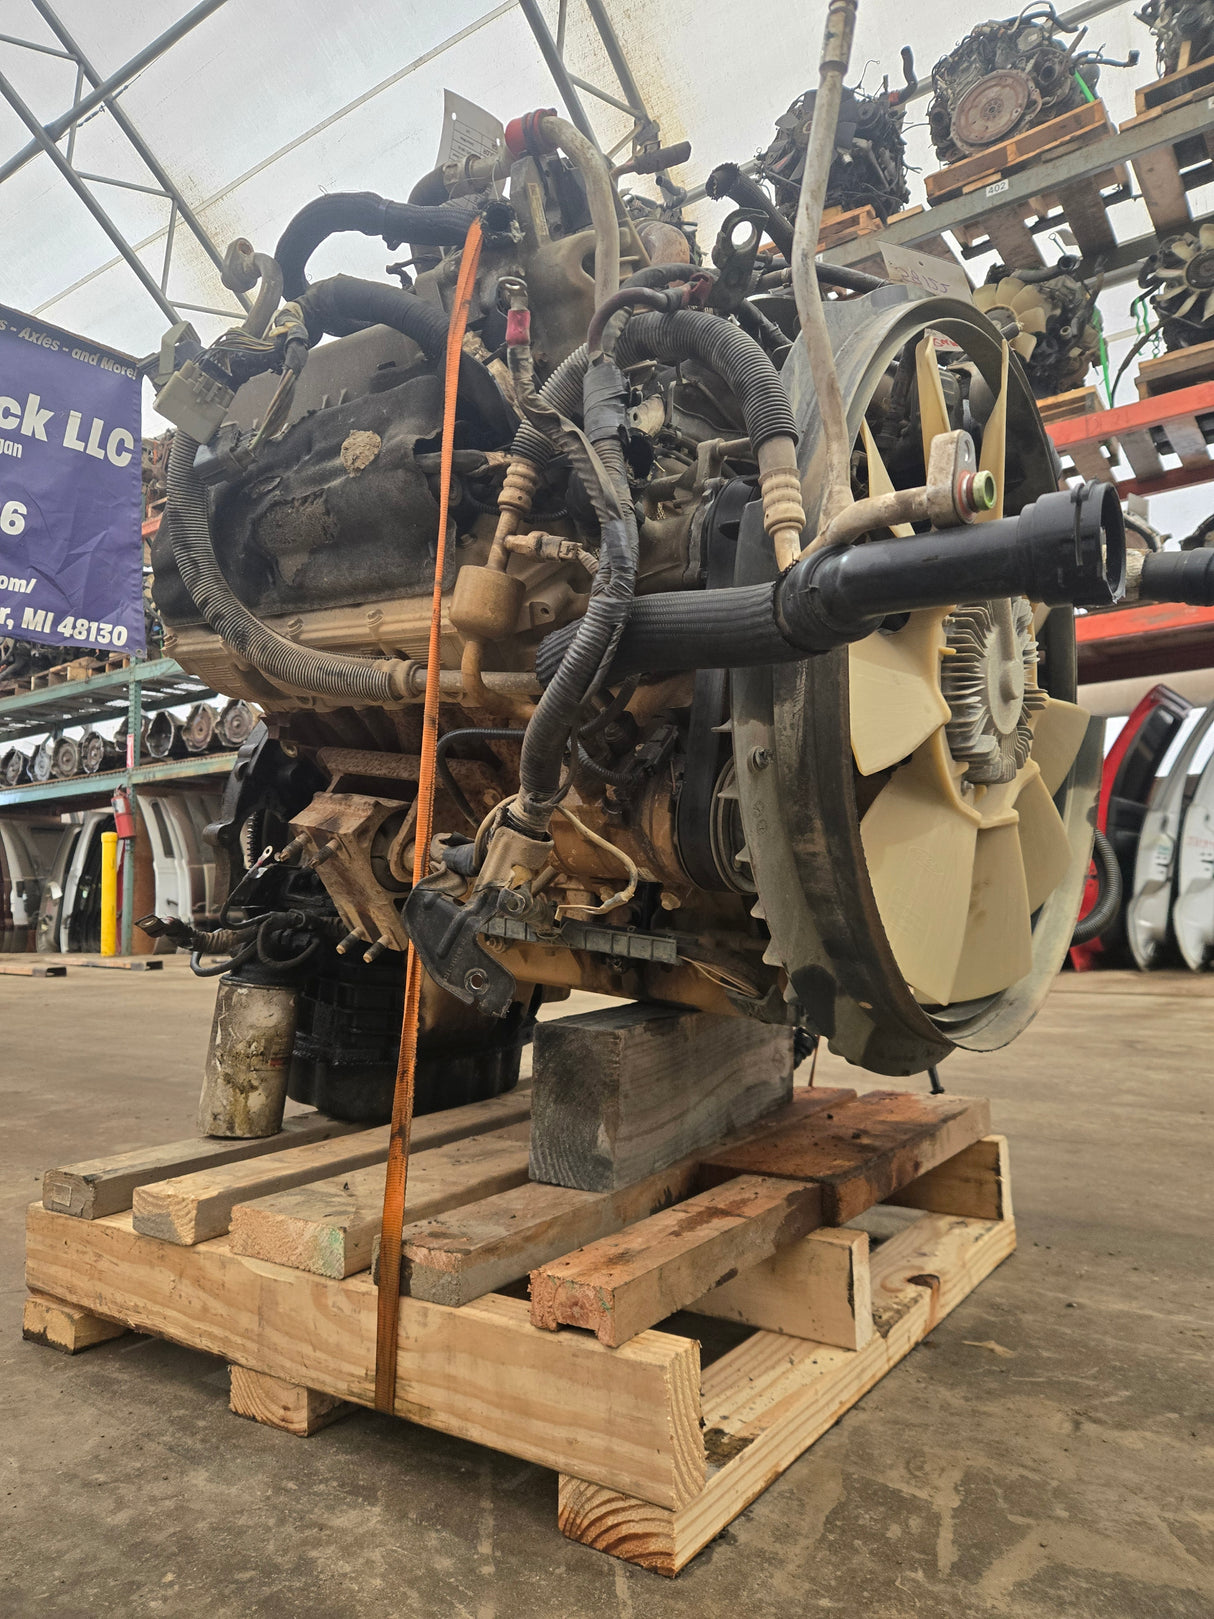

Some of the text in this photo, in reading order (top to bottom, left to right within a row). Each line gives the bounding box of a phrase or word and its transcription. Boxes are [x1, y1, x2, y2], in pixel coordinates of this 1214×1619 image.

[988, 181, 1007, 193] 402
[18, 327, 60, 351] Axles
[71, 348, 100, 366] and
[100, 357, 138, 380] More!
[62, 409, 134, 467] LLC
[0, 500, 28, 535] 6
[21, 607, 55, 633] MI
[57, 615, 128, 646] 48130
